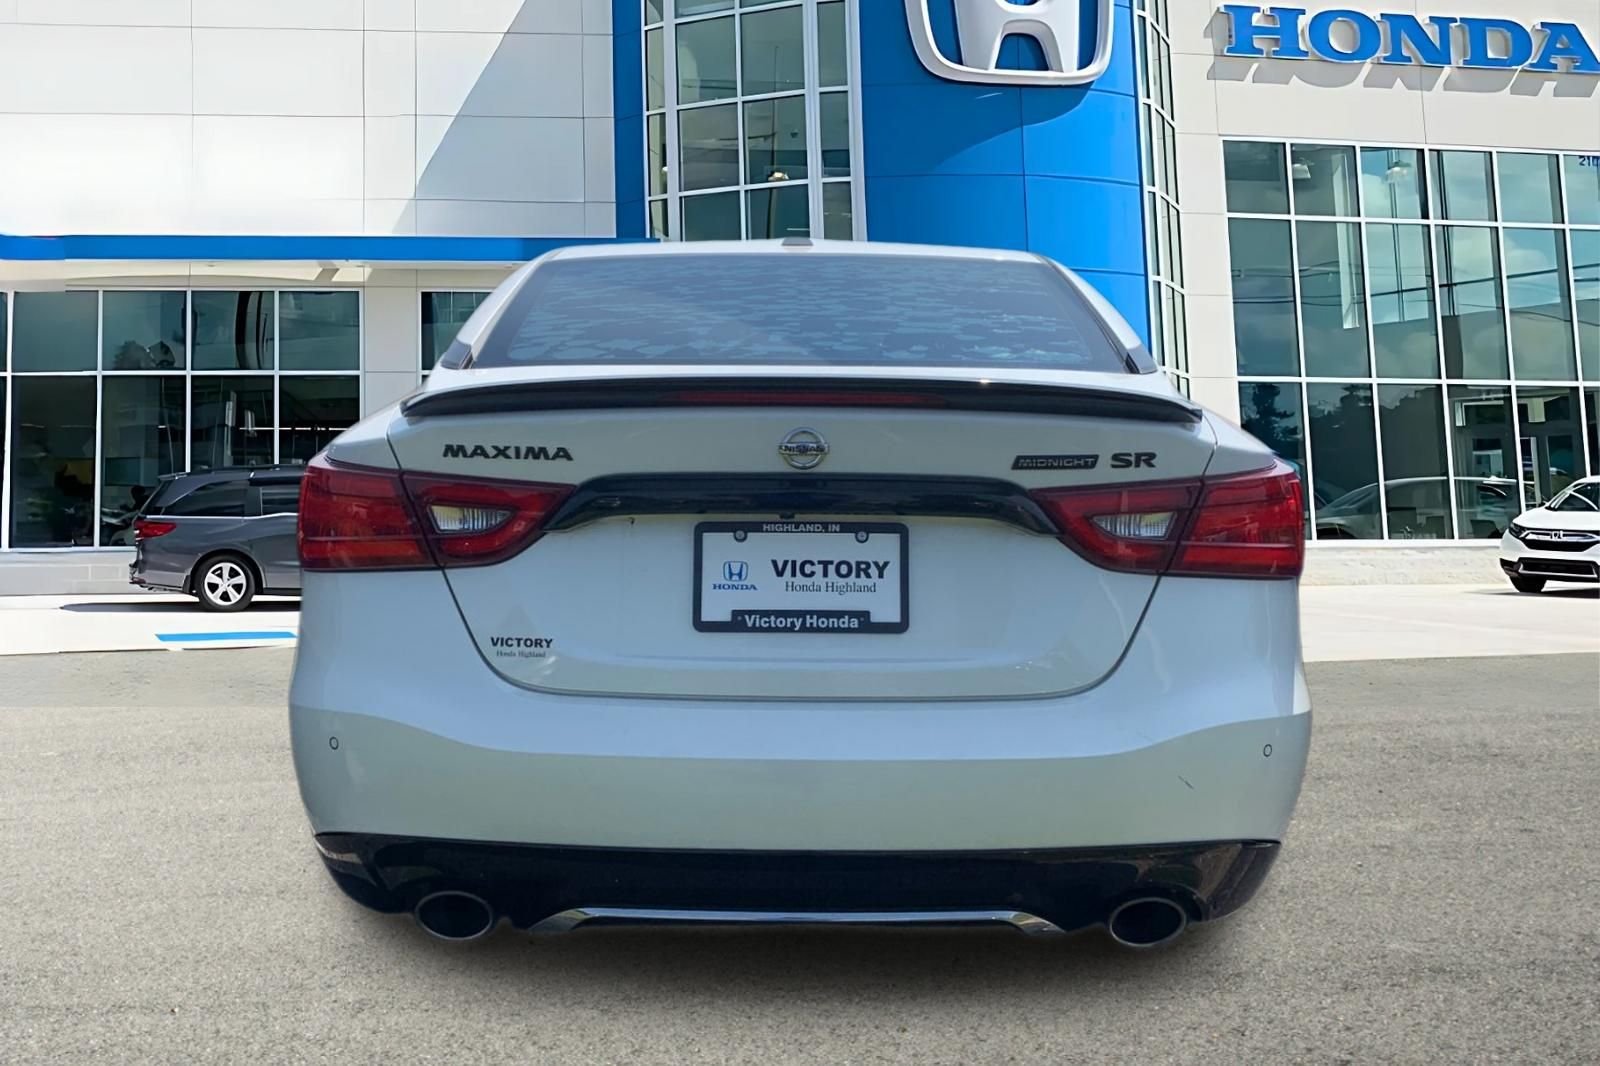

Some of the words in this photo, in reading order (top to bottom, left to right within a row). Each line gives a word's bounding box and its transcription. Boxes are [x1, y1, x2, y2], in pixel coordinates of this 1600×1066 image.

[1219, 4, 1600, 73] HONDA
[442, 444, 574, 461] MAXIMA
[1017, 457, 1095, 468] MIDNIGHT
[1110, 452, 1157, 469] SR
[763, 523, 825, 533] HIGHLAND,
[828, 523, 840, 532] IN
[771, 559, 890, 579] VICTORY
[712, 583, 758, 591] HONDA
[785, 581, 822, 593] Honda
[825, 581, 877, 596] Highland
[744, 614, 802, 631] Victory
[806, 615, 859, 629] Honda
[490, 636, 553, 648] VICTORY
